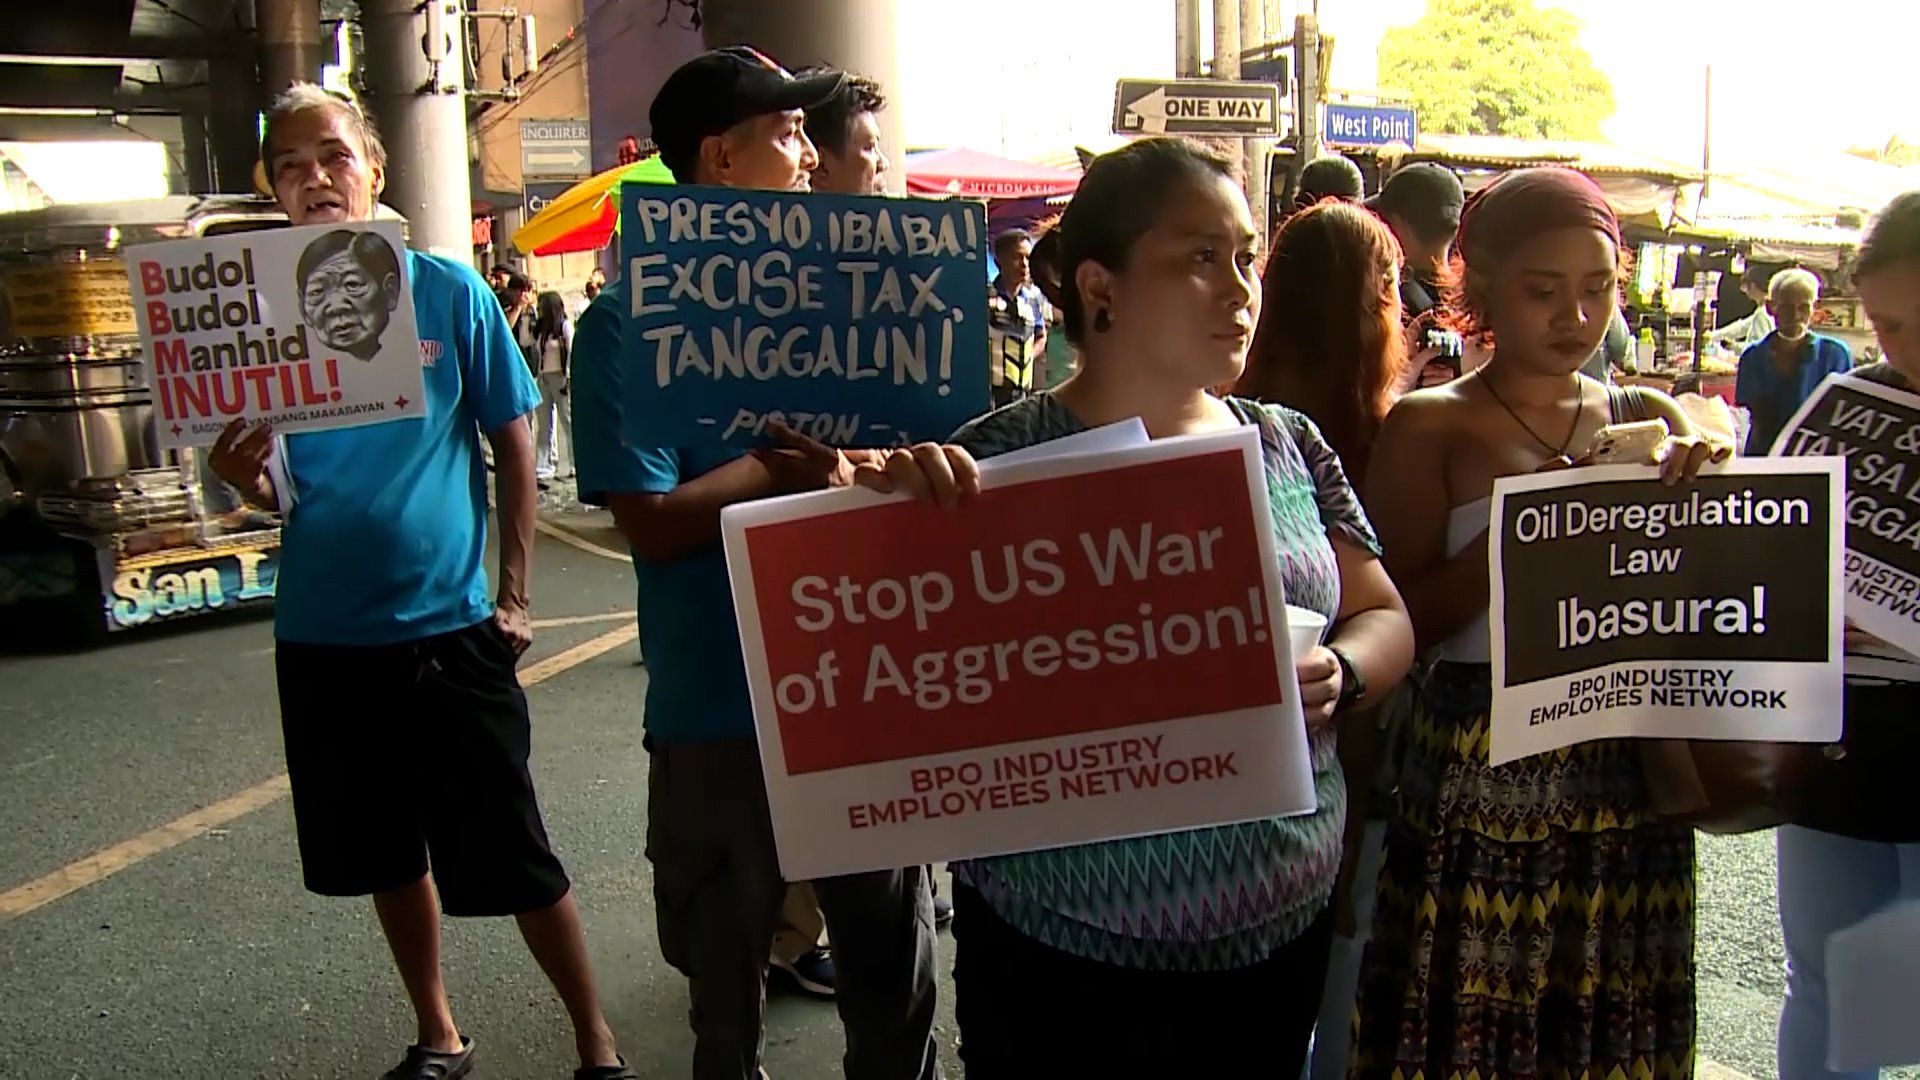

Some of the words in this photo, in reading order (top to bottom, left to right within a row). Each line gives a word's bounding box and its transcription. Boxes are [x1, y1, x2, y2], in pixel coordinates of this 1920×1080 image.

[522, 126, 588, 139] INQUIRER
[1165, 99, 1210, 117] ONE
[1217, 100, 1265, 119] WAY
[1331, 113, 1367, 138] West
[1372, 115, 1411, 139] Point
[828, 207, 977, 261] IBABA!
[139, 248, 255, 297] Budol
[630, 250, 826, 319] EXCISE
[146, 288, 261, 337] Budol
[153, 323, 310, 376] Manhid
[642, 315, 953, 397] TANGGALIN!
[157, 359, 343, 421] INUTIL!
[191, 420, 228, 435] BAGON
[309, 401, 386, 419] MAKABAYAN
[1830, 399, 1903, 441] VAT
[1894, 423, 1920, 455] &
[1852, 452, 1906, 494] SA
[1514, 502, 1558, 544] Oil
[1565, 489, 1811, 539] Deregulation
[791, 569, 955, 633] Stop
[969, 538, 1067, 604] US
[1078, 522, 1224, 588] War
[1608, 543, 1683, 577] Law
[1845, 552, 1920, 602] DUSTR
[111, 567, 226, 627] San
[234, 551, 280, 600] L
[1848, 578, 1920, 624] NETWO
[1557, 584, 1768, 649] Ibasura!
[775, 649, 841, 715] of
[862, 586, 1269, 711] Aggression!
[1529, 687, 1643, 727] EMPLOYEES
[1649, 687, 1788, 709] NETWORK
[1567, 674, 1606, 700] BPO
[1610, 668, 1734, 690] INDUSTRY
[848, 779, 1051, 830] EMPLOYEES
[1060, 751, 1239, 800] NETWORK
[909, 761, 984, 795] BPO
[992, 734, 1166, 781] INDUSTRY
